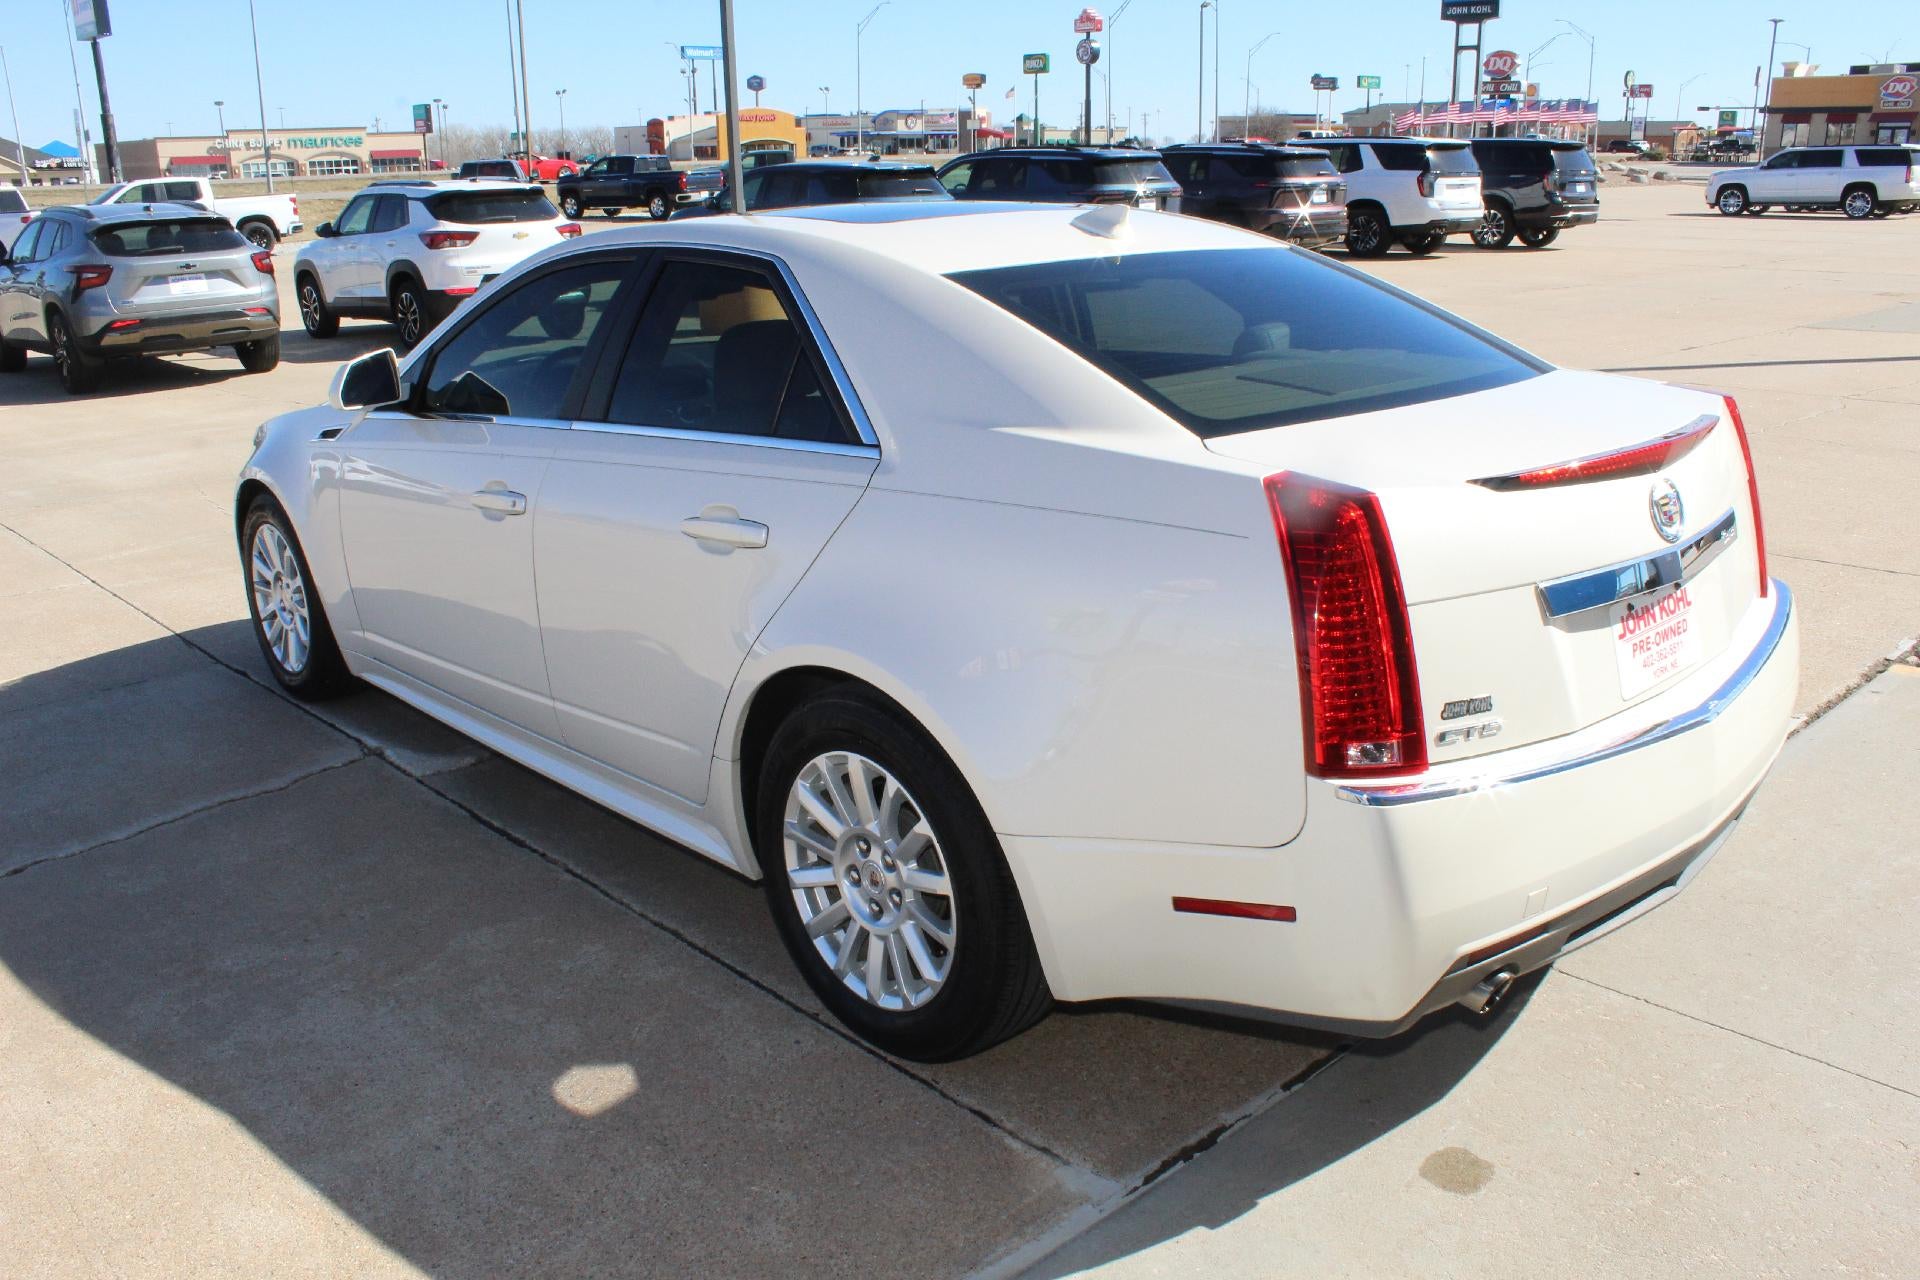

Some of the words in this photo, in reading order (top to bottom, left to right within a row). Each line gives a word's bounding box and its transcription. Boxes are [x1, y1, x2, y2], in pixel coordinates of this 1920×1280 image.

[1447, 7, 1468, 15] JOHN
[1470, 6, 1492, 14] KOHL
[686, 48, 714, 57] Walmart
[1488, 56, 1512, 71] DQ
[1499, 83, 1518, 92] Chill
[1888, 82, 1911, 94] DQ
[215, 138, 245, 149] CHINA
[287, 135, 363, 149] maurices
[1618, 603, 1657, 640] JOHN
[1658, 587, 1692, 620] KOHL
[1632, 618, 1688, 658] PRE-OWNED
[1441, 701, 1468, 720] JOHN
[1469, 696, 1492, 715] KOHL
[1434, 721, 1502, 747] CTS
